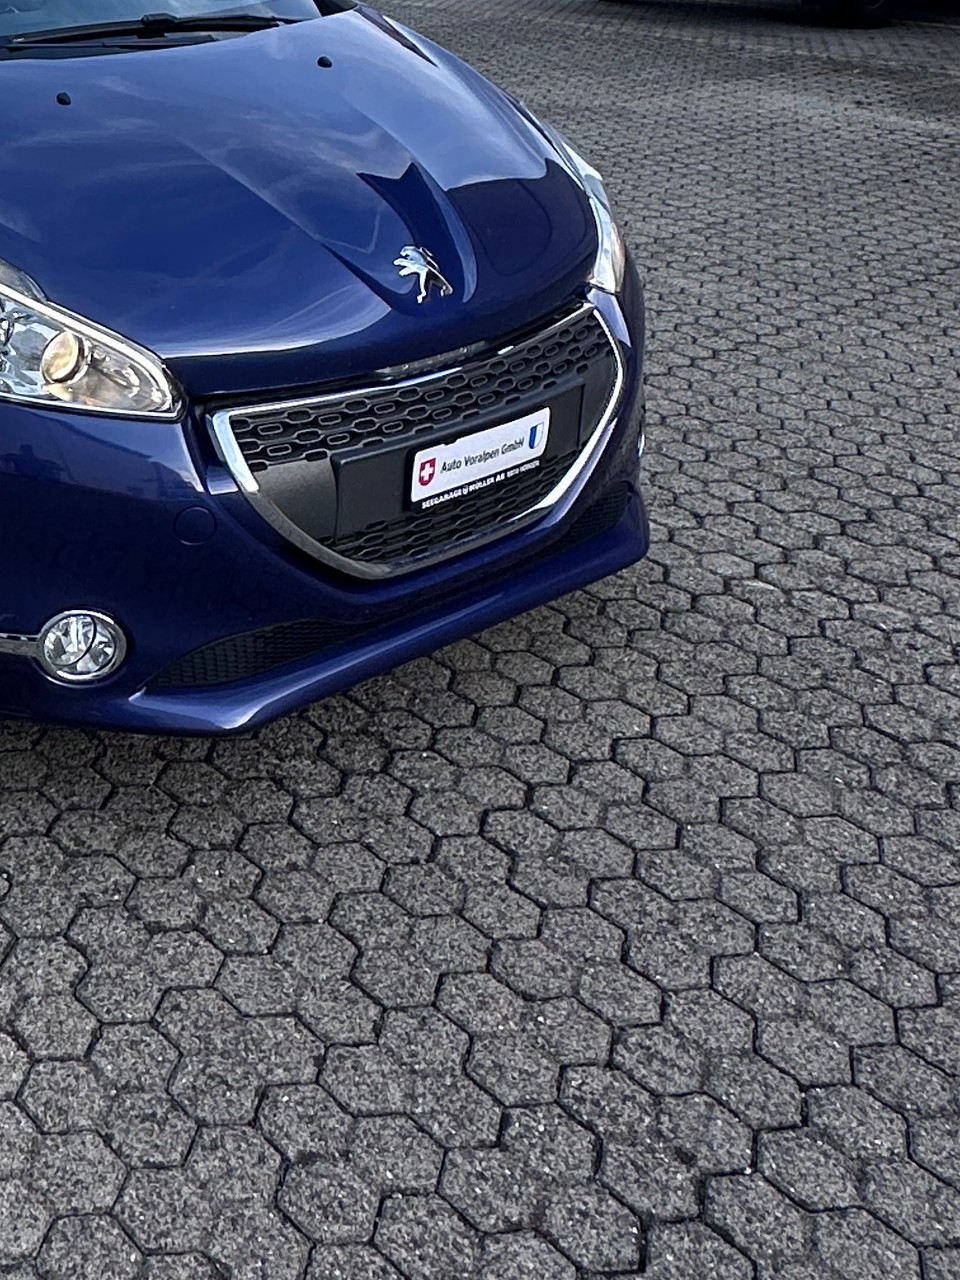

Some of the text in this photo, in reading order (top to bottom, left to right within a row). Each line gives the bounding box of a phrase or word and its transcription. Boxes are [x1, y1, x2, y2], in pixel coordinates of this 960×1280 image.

[440, 459, 462, 474] Auto
[463, 448, 500, 467] Voralpen
[501, 437, 525, 455] GmbH
